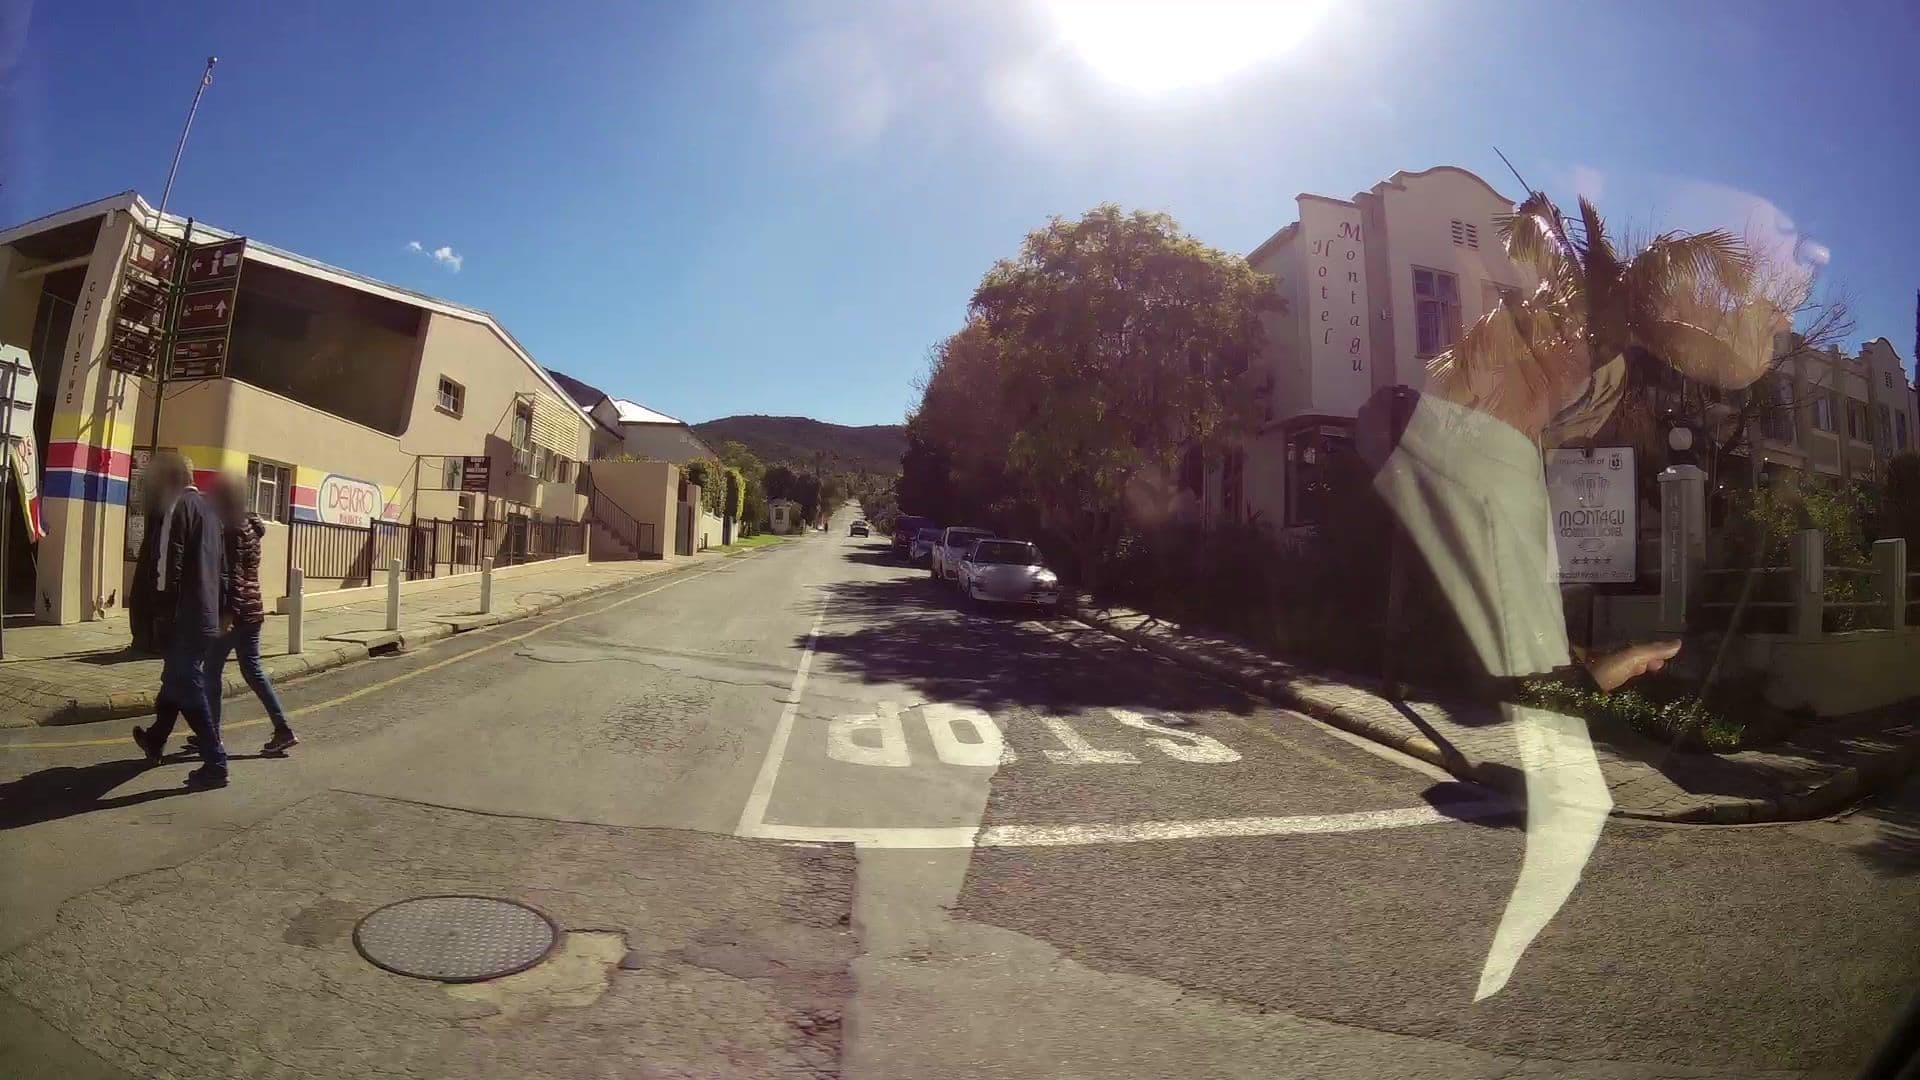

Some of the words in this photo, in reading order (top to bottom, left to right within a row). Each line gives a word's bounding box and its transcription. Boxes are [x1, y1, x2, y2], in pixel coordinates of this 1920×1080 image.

[1312, 239, 1334, 345] Hotel
[1337, 222, 1363, 372] Montagu
[328, 482, 374, 514] DEKRO
[1559, 509, 1625, 527] MONTAGU
[826, 702, 1242, 767] STOP
